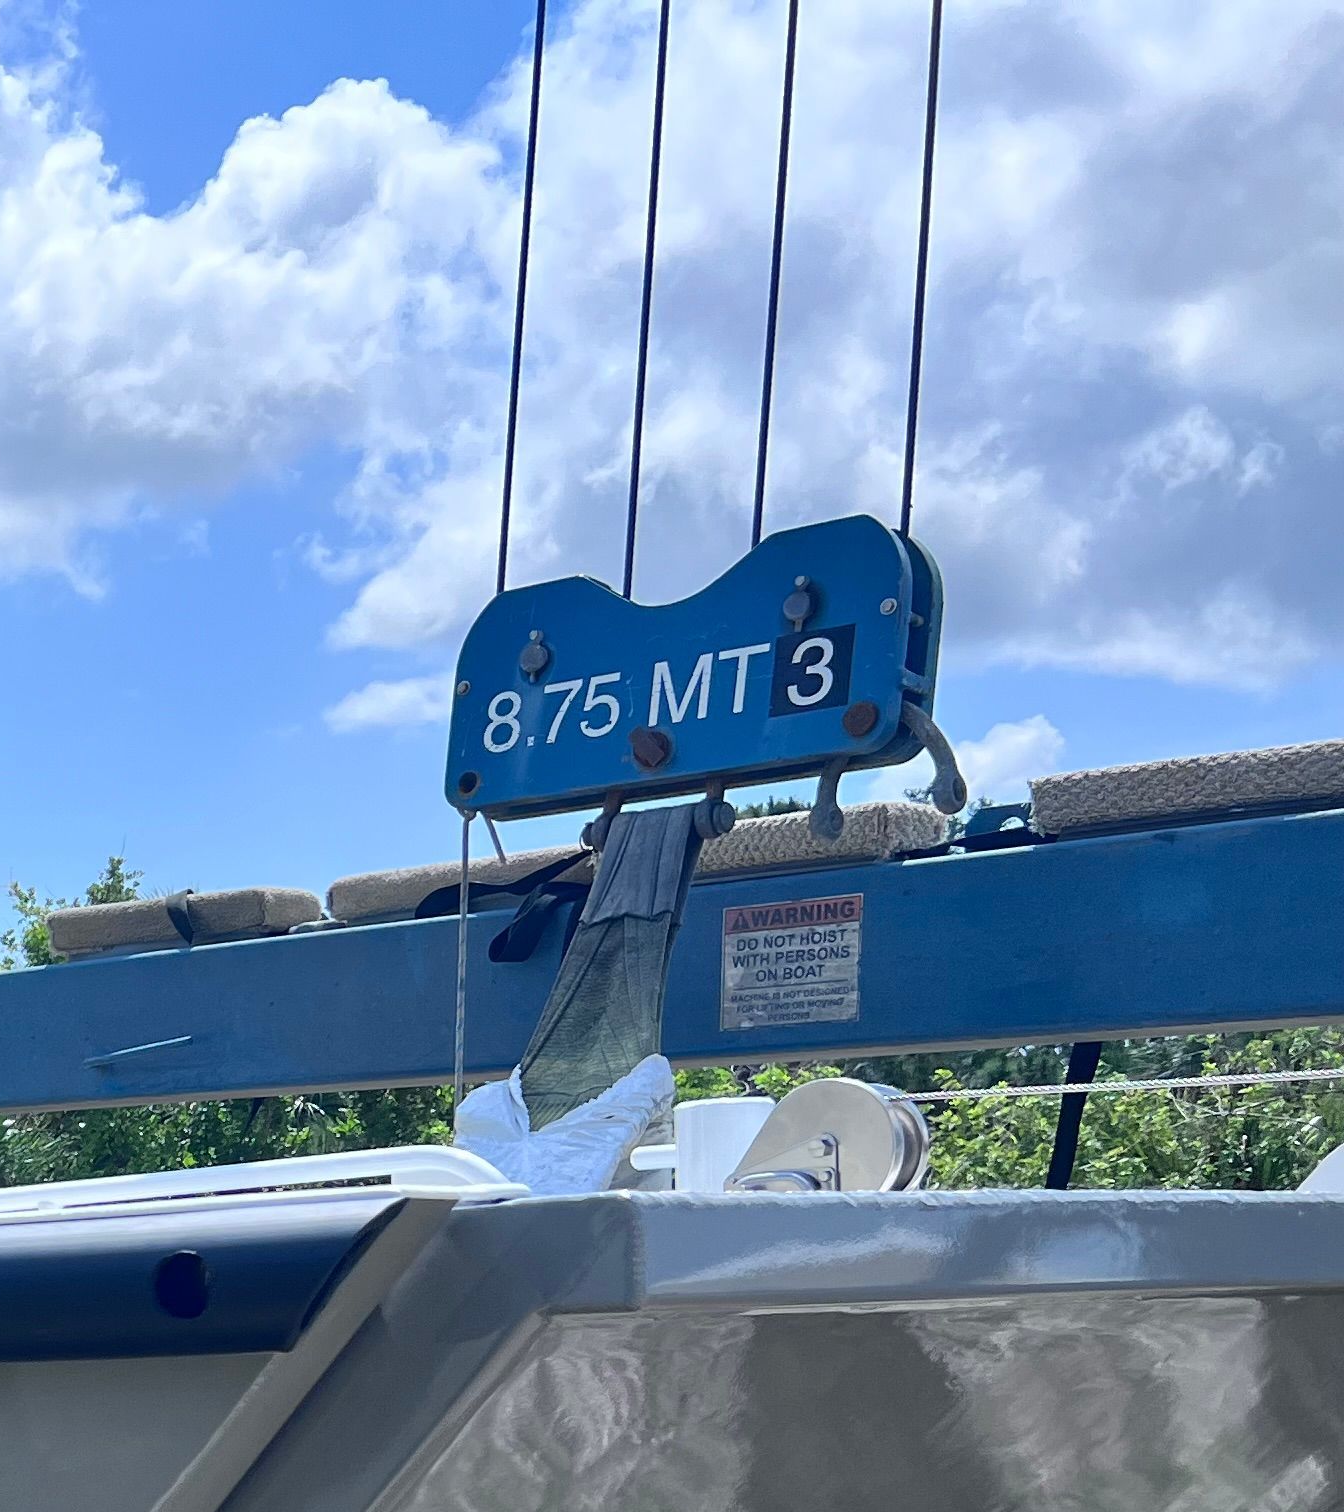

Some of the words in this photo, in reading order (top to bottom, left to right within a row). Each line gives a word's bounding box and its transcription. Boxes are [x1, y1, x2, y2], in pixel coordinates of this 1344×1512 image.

[483, 671, 621, 753] 8.75
[648, 642, 771, 727] MT
[786, 636, 835, 707] 3
[751, 901, 855, 927] WARNING
[736, 938, 759, 951] DO
[763, 934, 796, 948] NOT
[799, 929, 848, 945] HOIST
[732, 953, 770, 969] WITH
[775, 945, 851, 965] PERSONS
[755, 970, 778, 983] ON
[782, 965, 825, 980] BOAT
[731, 993, 770, 1003] MACHINE
[772, 992, 780, 1001] IS
[783, 990, 801, 999] NOT
[803, 986, 850, 998] DESIGNED
[736, 1004, 754, 1014] FOR
[755, 1002, 790, 1012] LIFTING
[791, 1000, 805, 1010] OR
[807, 997, 845, 1009] MOVING
[768, 1012, 810, 1022] PERSONS
